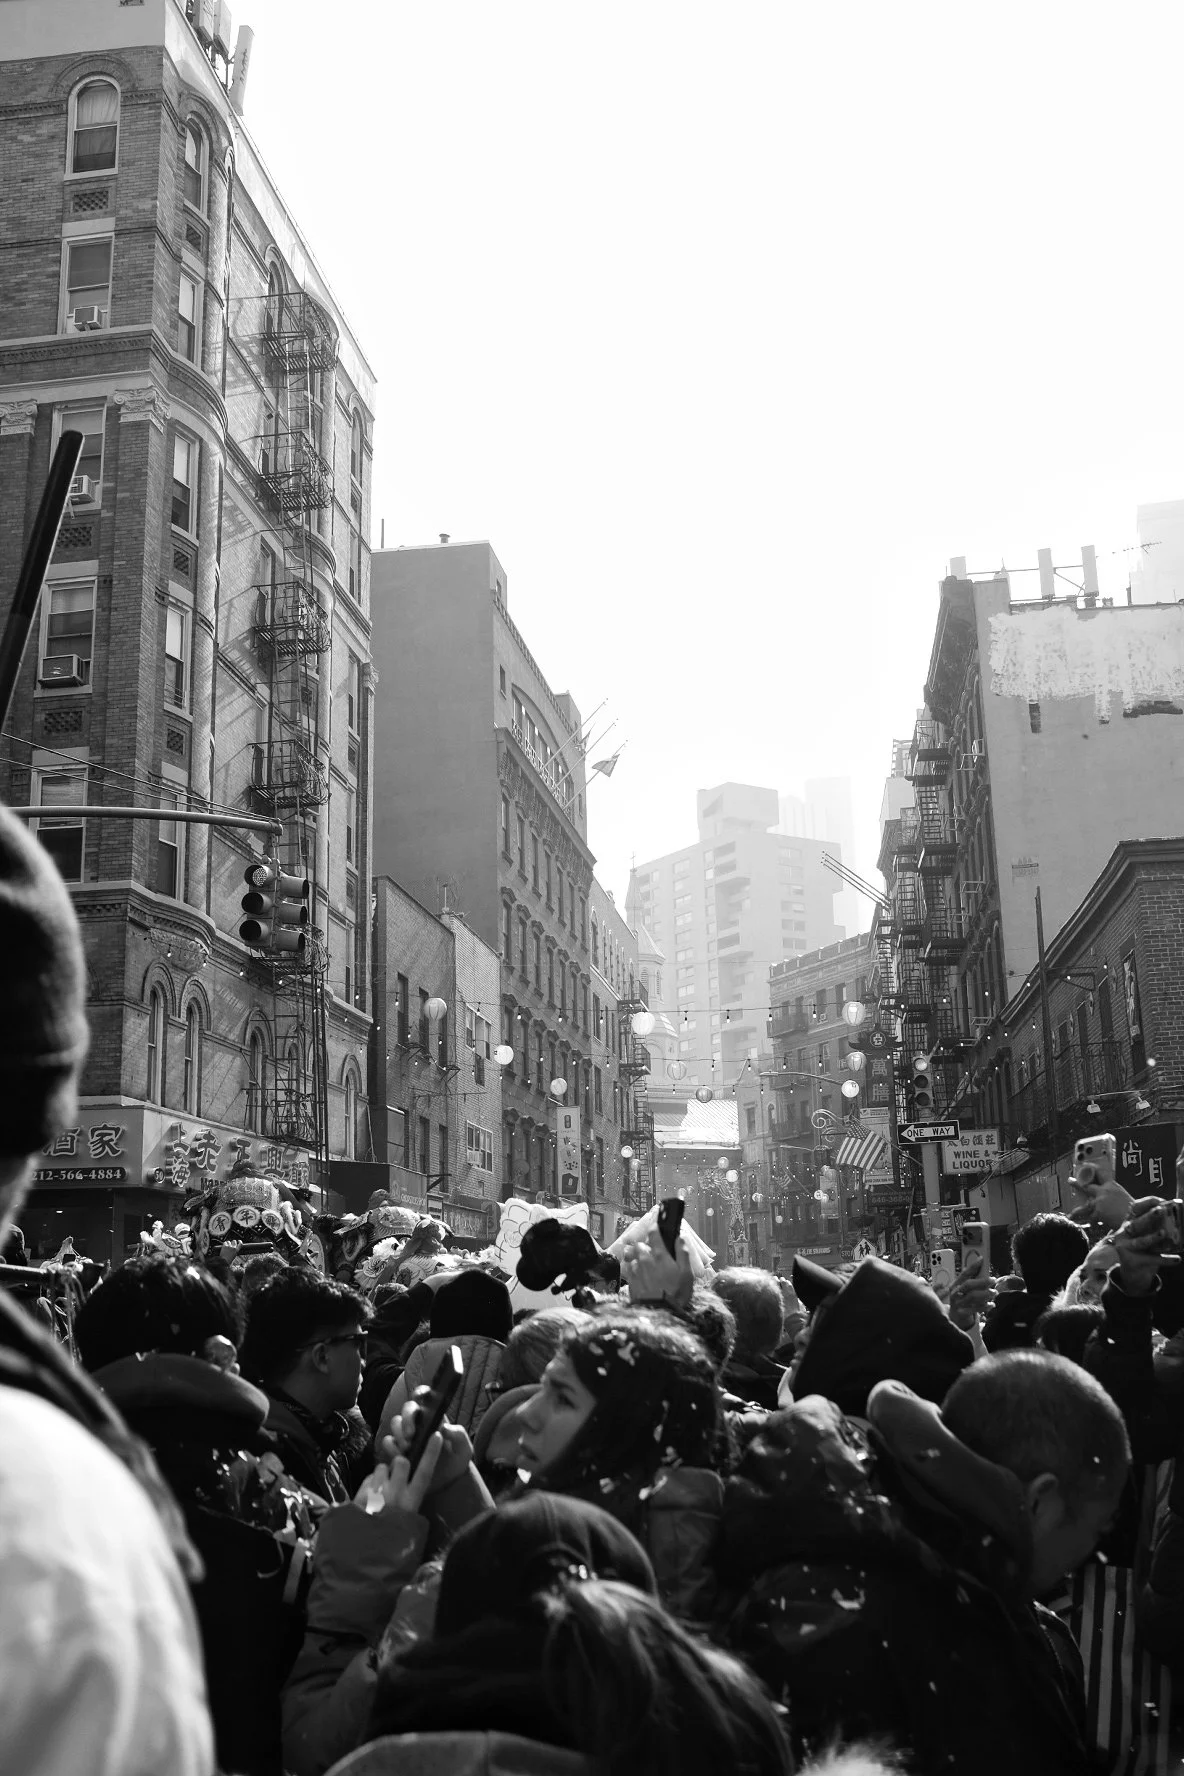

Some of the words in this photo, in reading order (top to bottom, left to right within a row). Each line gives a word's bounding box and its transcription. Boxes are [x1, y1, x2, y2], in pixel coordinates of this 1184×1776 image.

[907, 1129, 924, 1138] ONE
[932, 1127, 951, 1136] WAY
[953, 1150, 980, 1159] WINE
[32, 1169, 121, 1180] 212-566-4884
